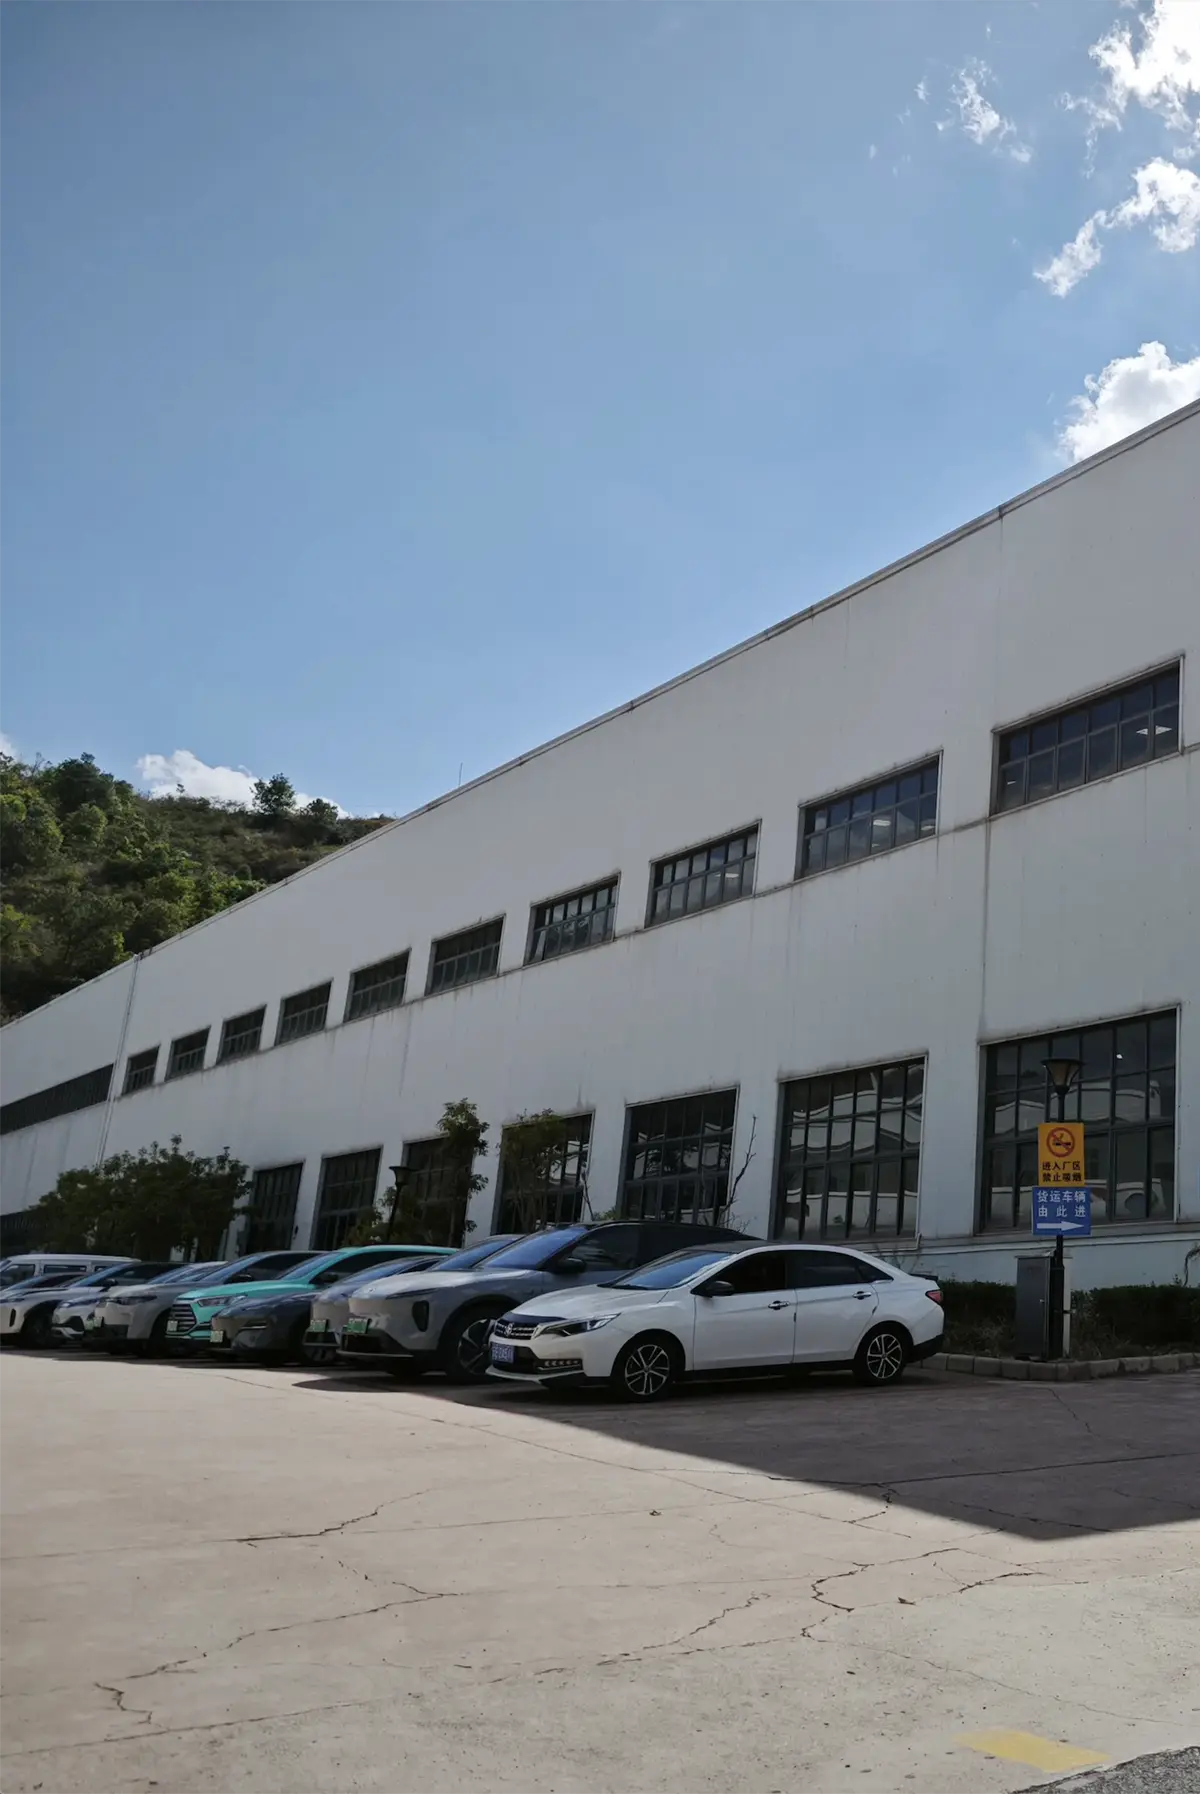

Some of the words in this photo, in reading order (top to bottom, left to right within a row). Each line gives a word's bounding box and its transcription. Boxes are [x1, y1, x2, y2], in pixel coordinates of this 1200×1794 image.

[1042, 1161, 1081, 1171] 进入厂区
[1042, 1172, 1082, 1182] 禁止吸烟
[1037, 1190, 1086, 1203] 货运车辆
[1038, 1205, 1086, 1217] 由此进
